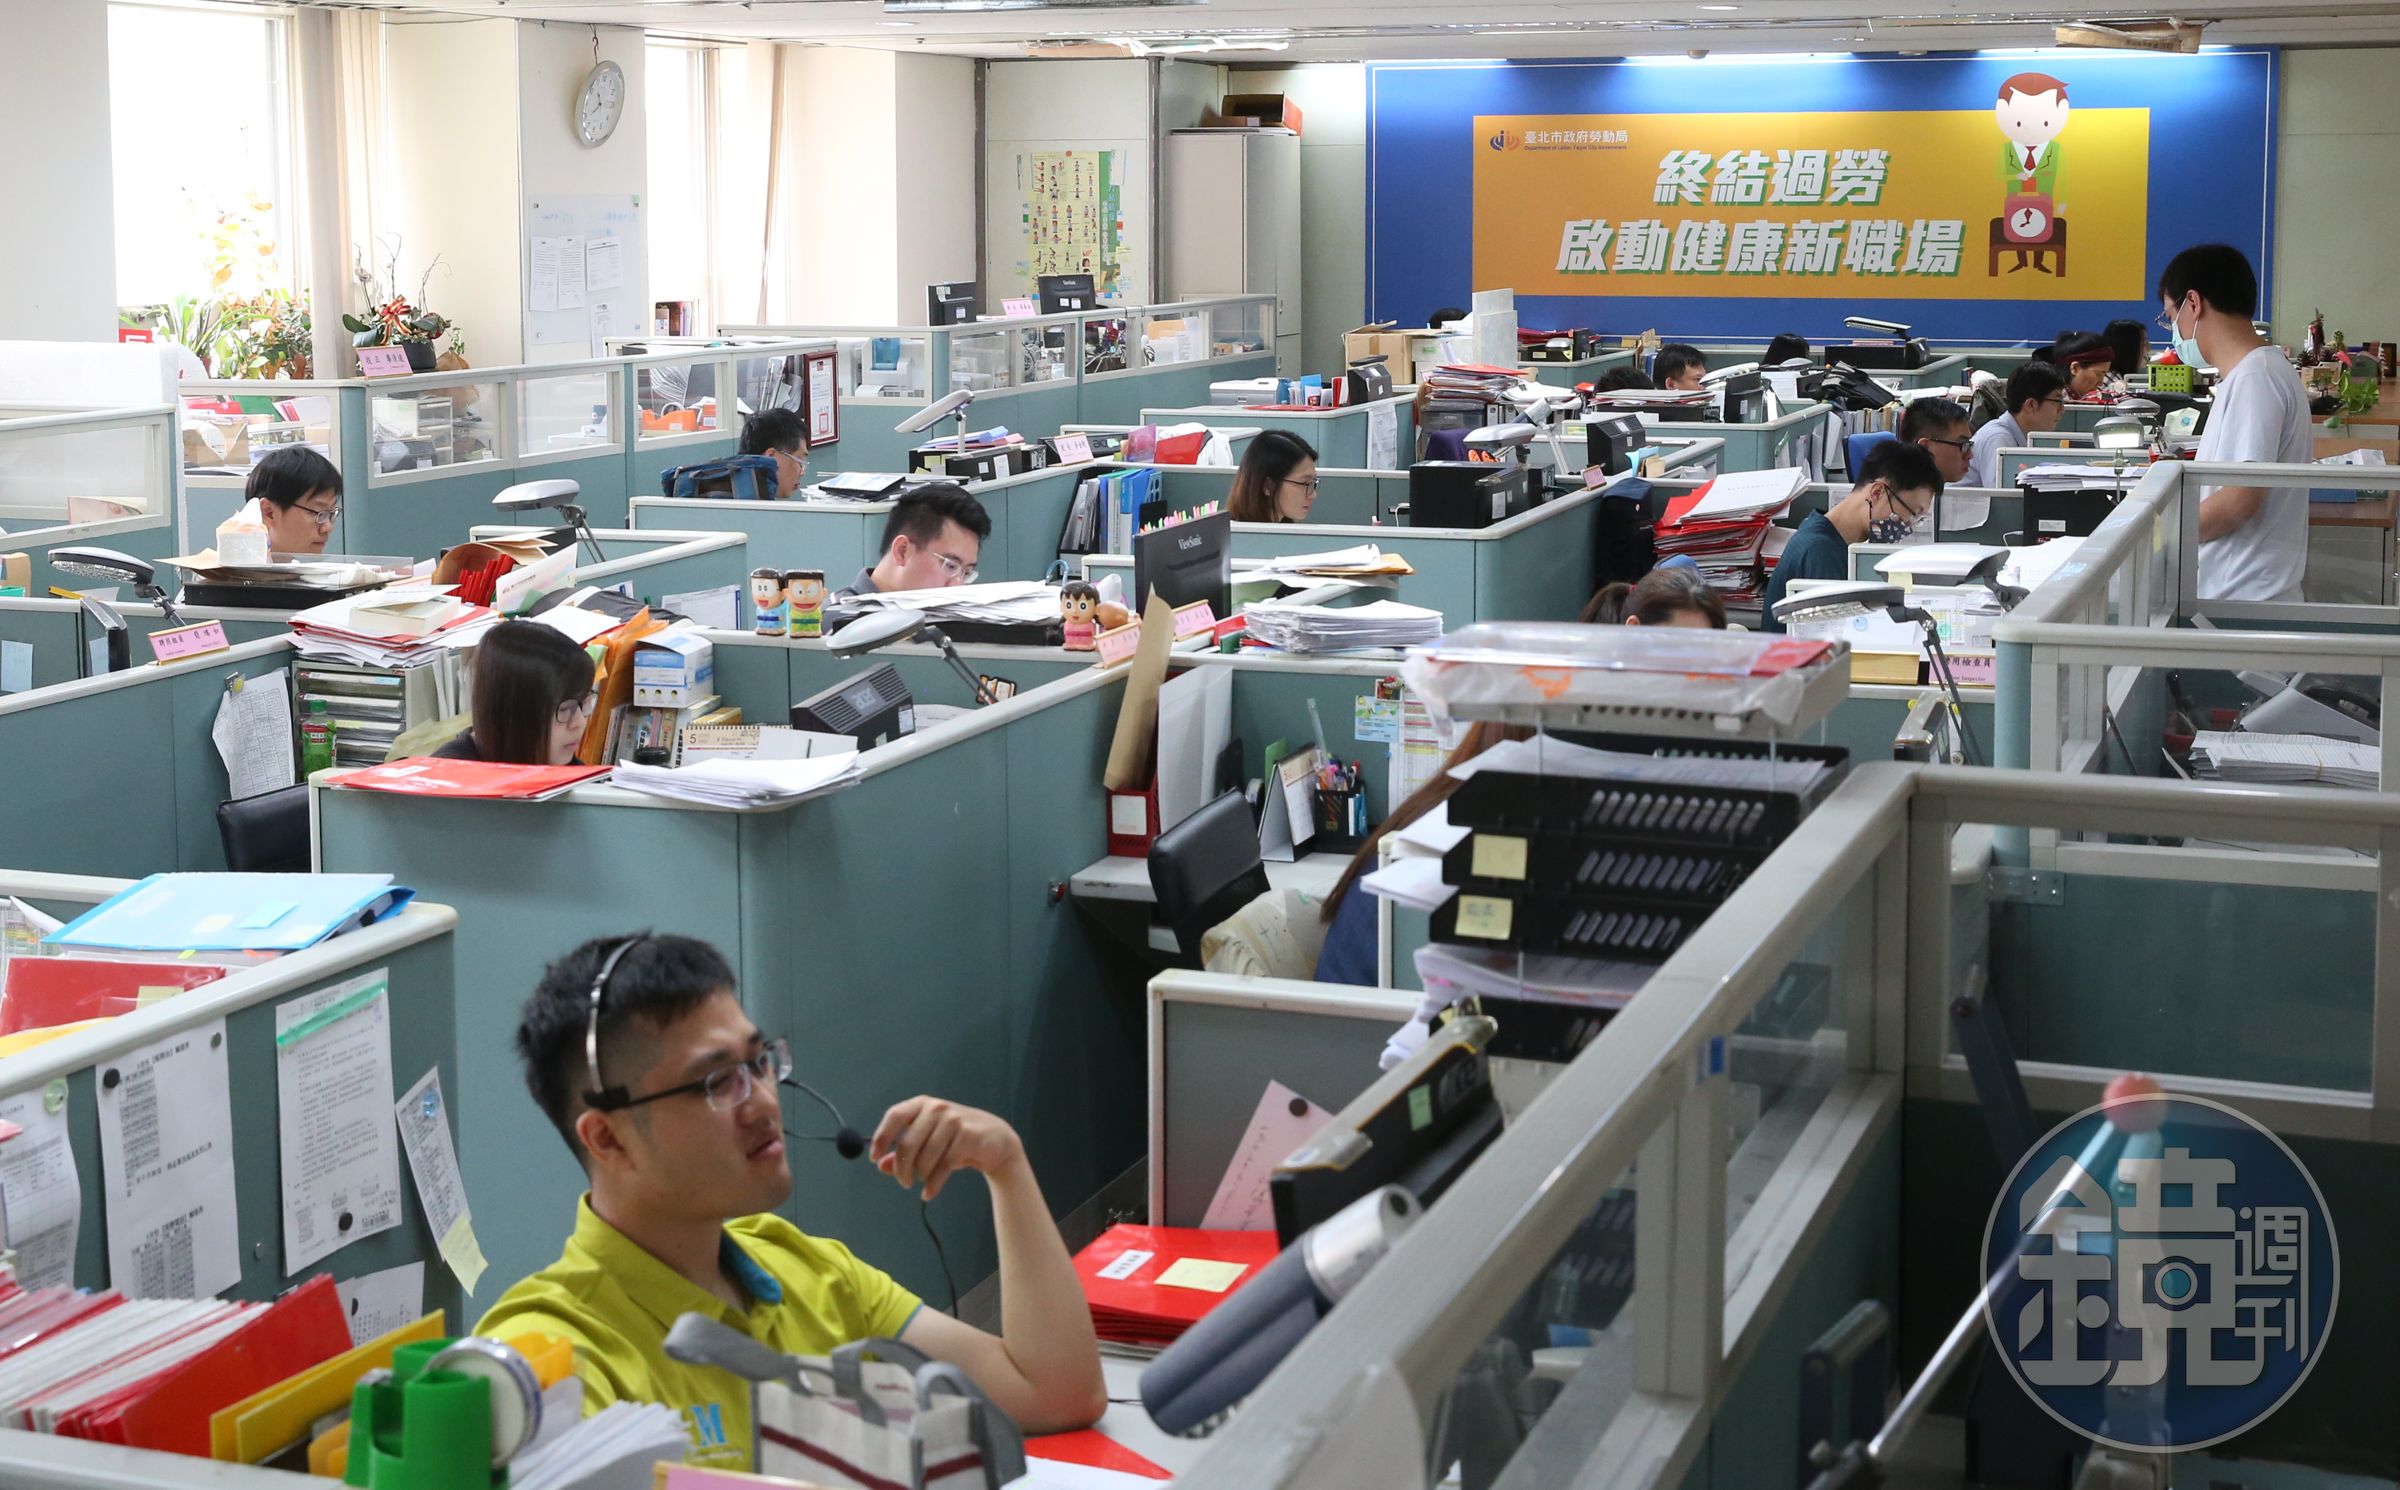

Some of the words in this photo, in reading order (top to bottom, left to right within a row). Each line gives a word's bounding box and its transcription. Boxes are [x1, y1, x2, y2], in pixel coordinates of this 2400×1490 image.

[1524, 130, 1628, 144] 臺北市政府勞動局
[1652, 148, 1888, 206] 終結過勞
[1555, 218, 1967, 276] 啟動健康新職場
[1177, 533, 1203, 550] ViewSonic
[689, 732, 697, 744] 5
